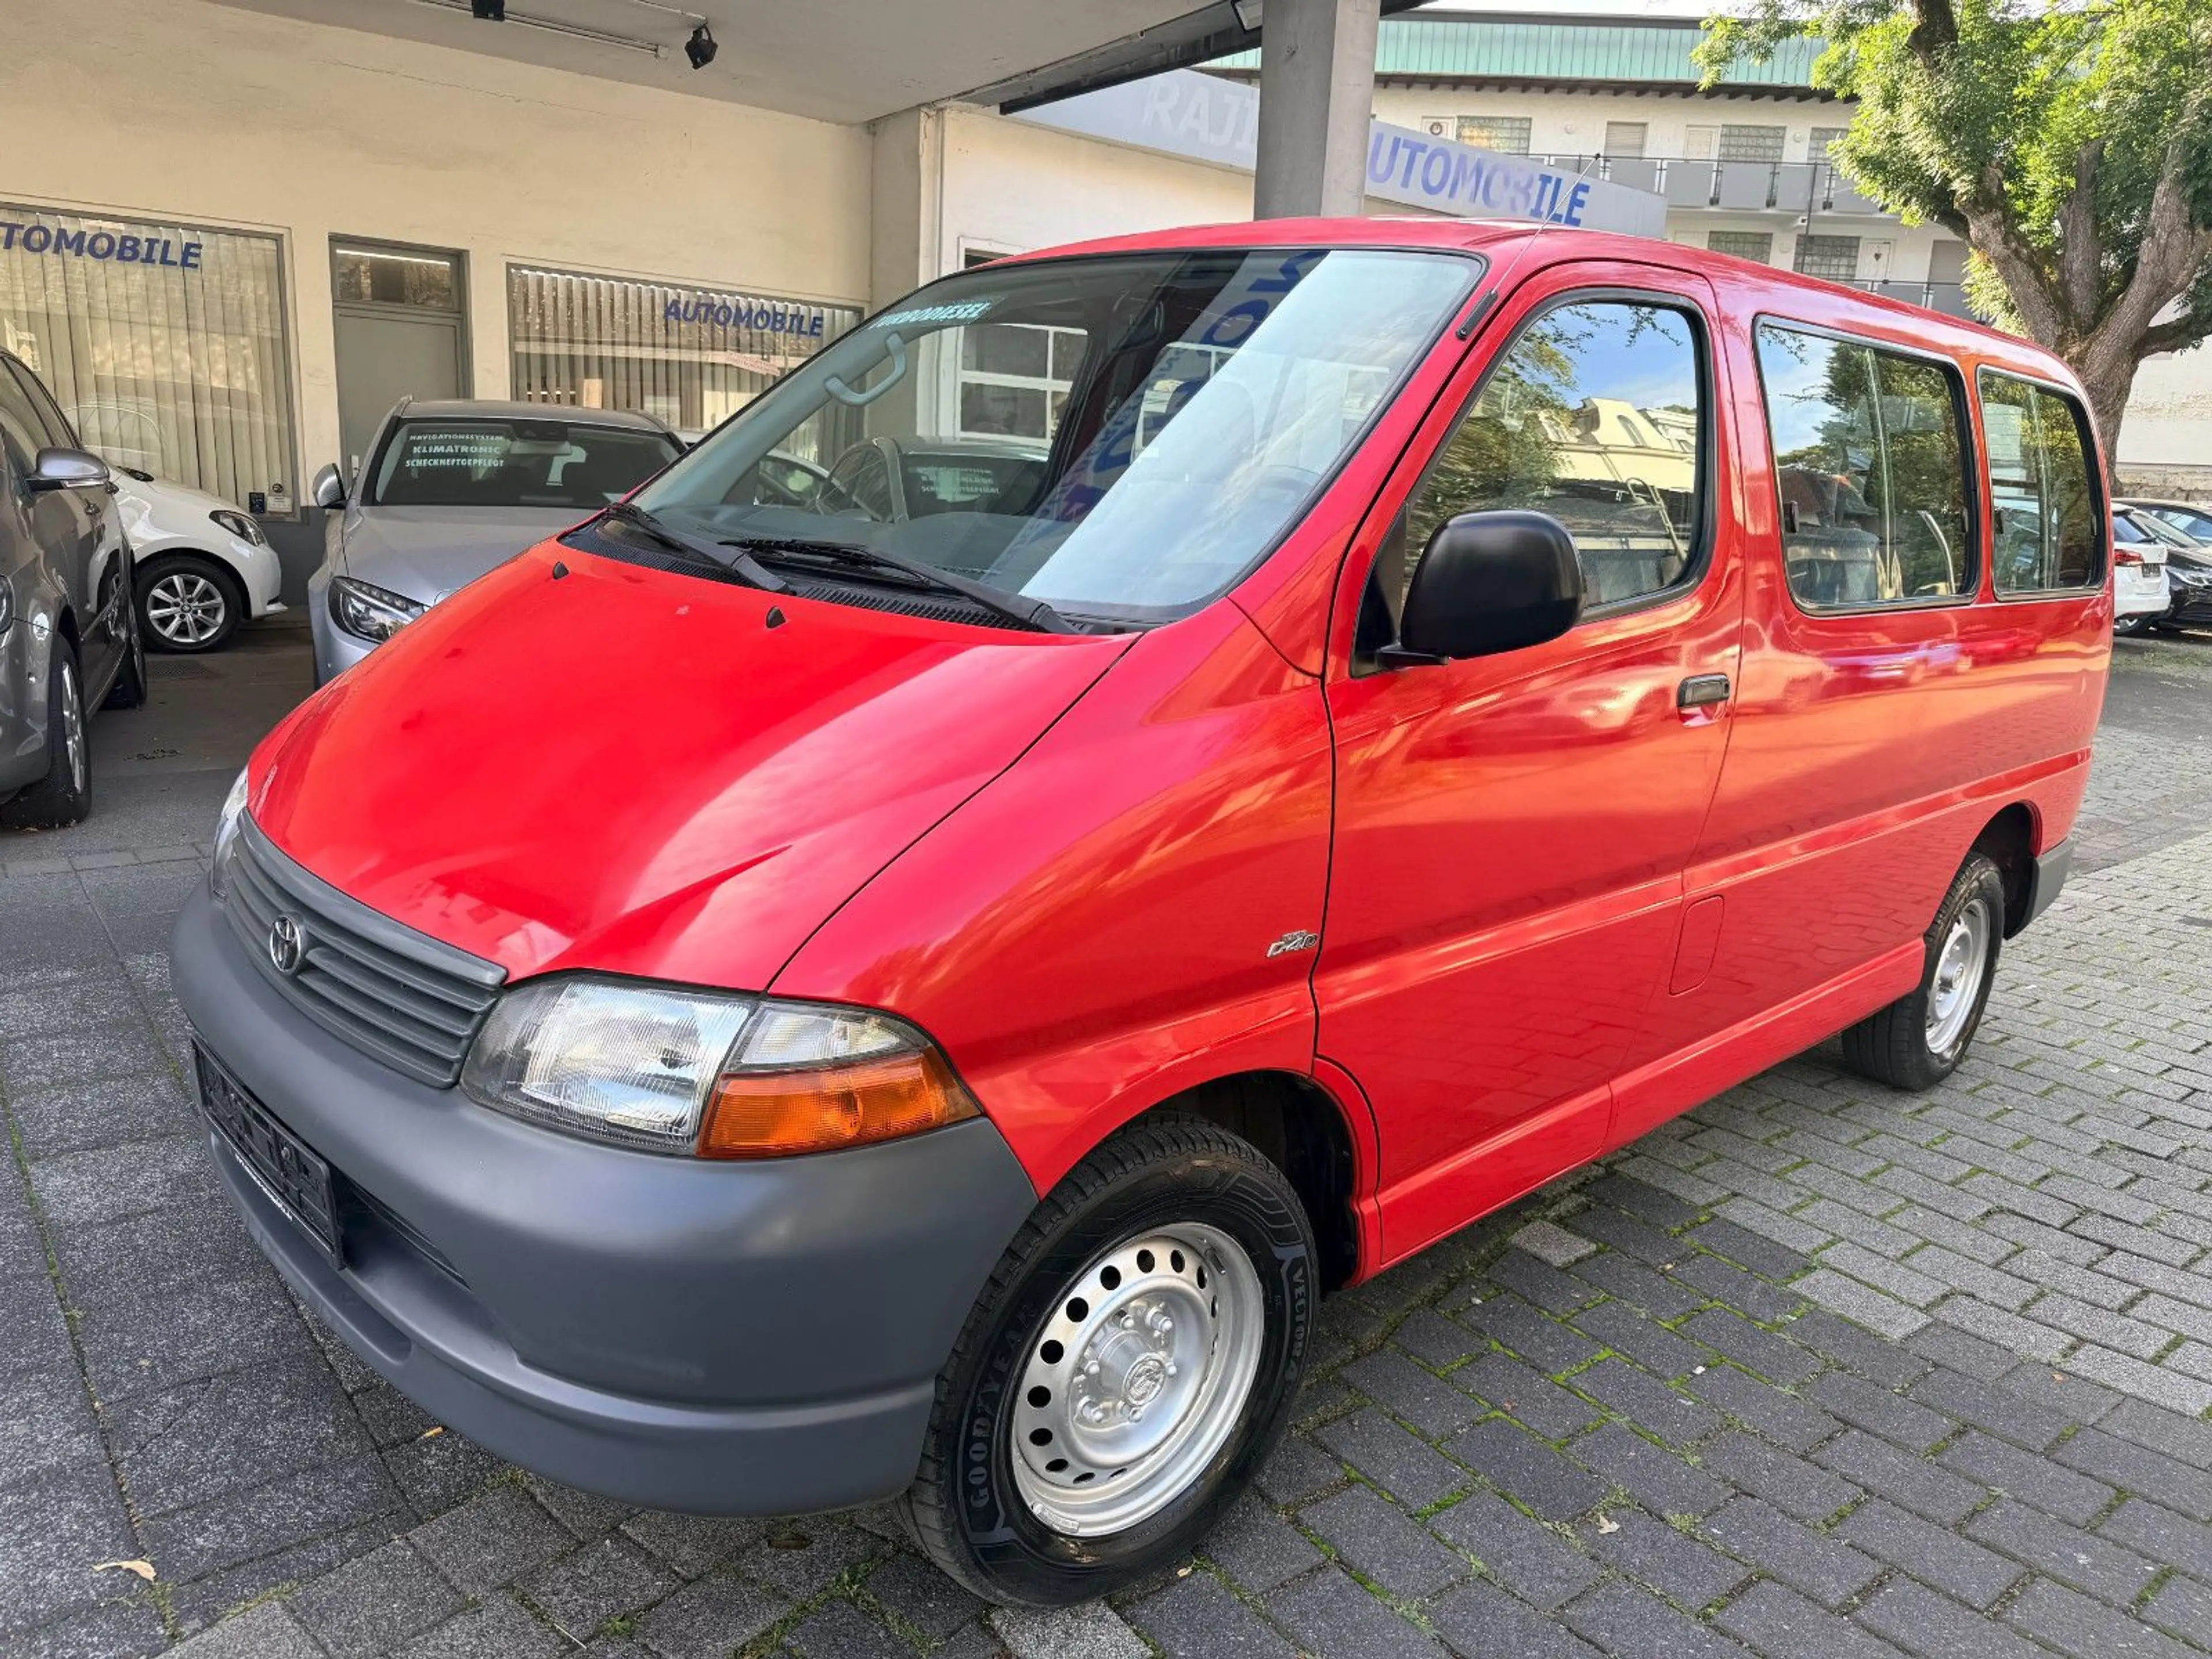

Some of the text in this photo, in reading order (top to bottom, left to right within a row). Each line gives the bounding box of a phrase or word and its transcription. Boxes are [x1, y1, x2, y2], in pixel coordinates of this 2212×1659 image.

[664, 299, 824, 336] AUTOMOBILE
[412, 445, 501, 454] KLIMATRONIC
[1292, 1267, 1306, 1357] VECTOR
[968, 1304, 1036, 1508] GOODYEAR
